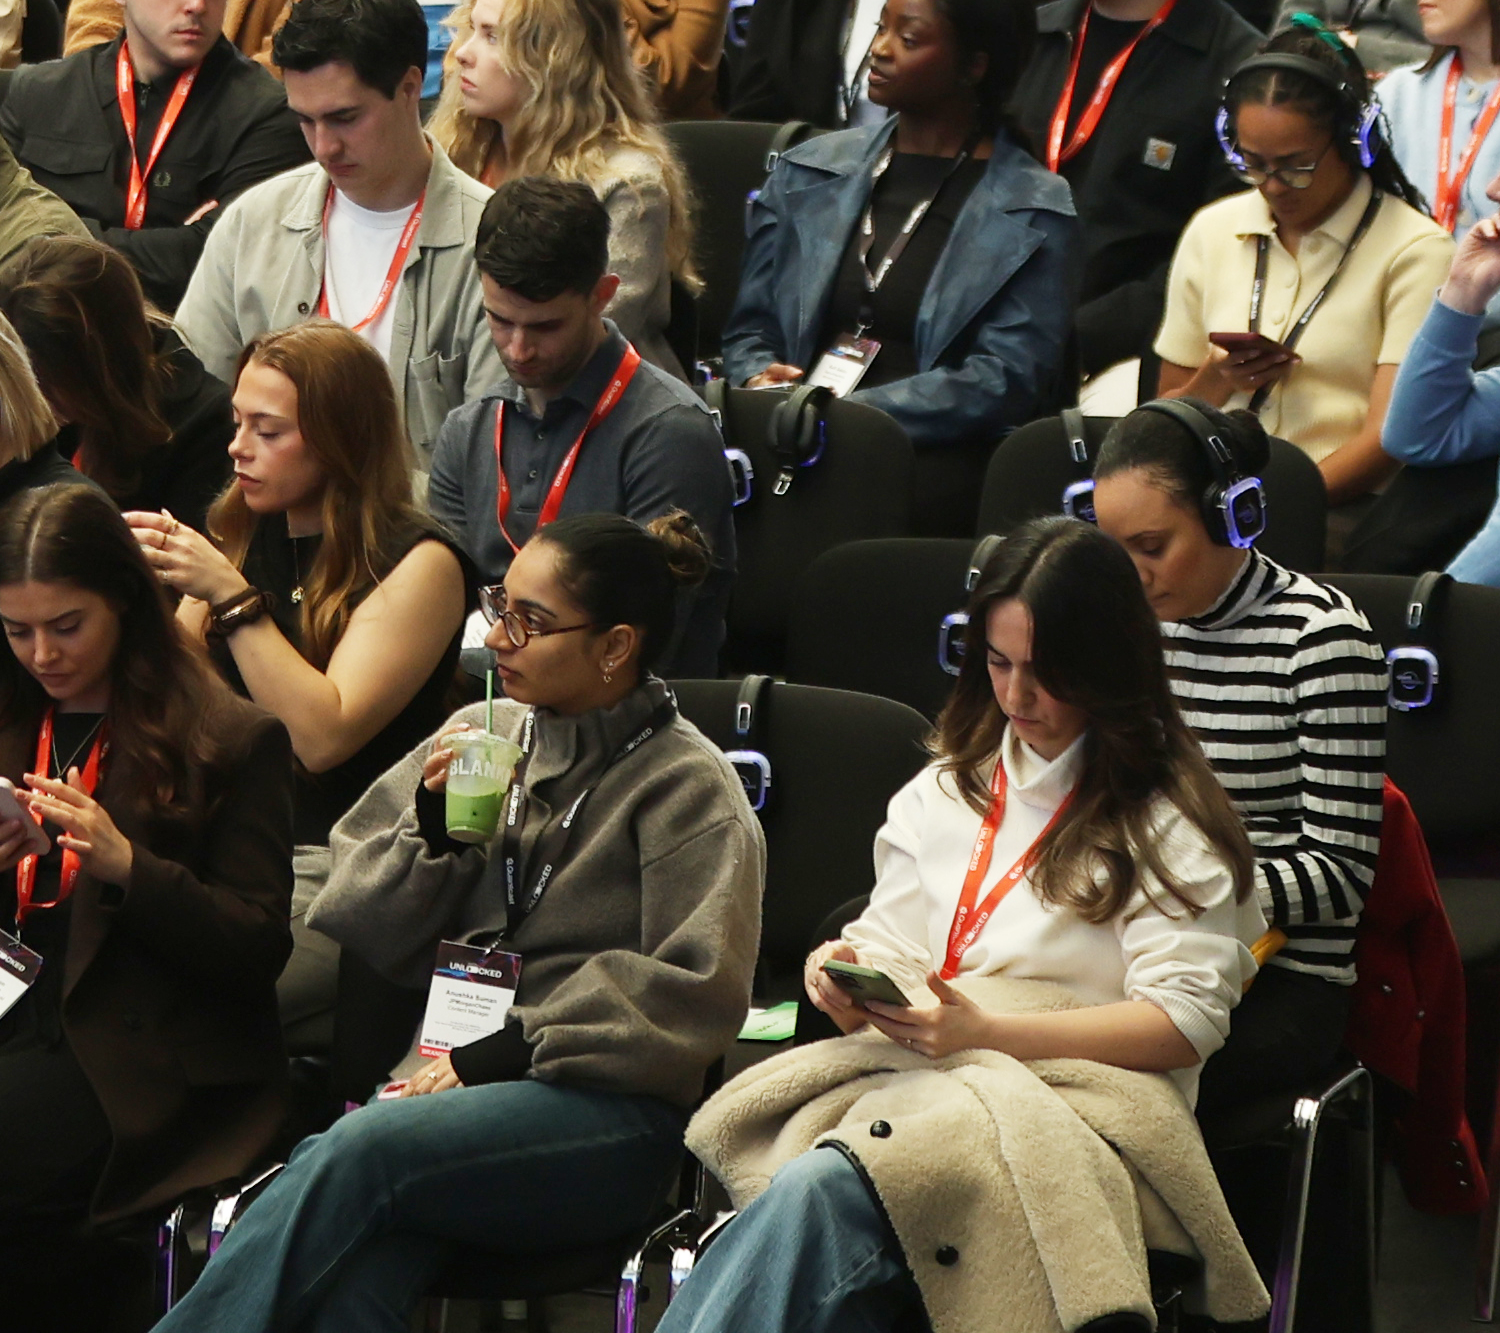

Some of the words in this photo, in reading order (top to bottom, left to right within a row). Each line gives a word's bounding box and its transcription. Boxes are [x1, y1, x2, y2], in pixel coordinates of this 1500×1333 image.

[507, 784, 522, 827] UNLOCKED
[968, 826, 990, 873] UNLOCKED
[449, 961, 503, 979] UNLOCKED
